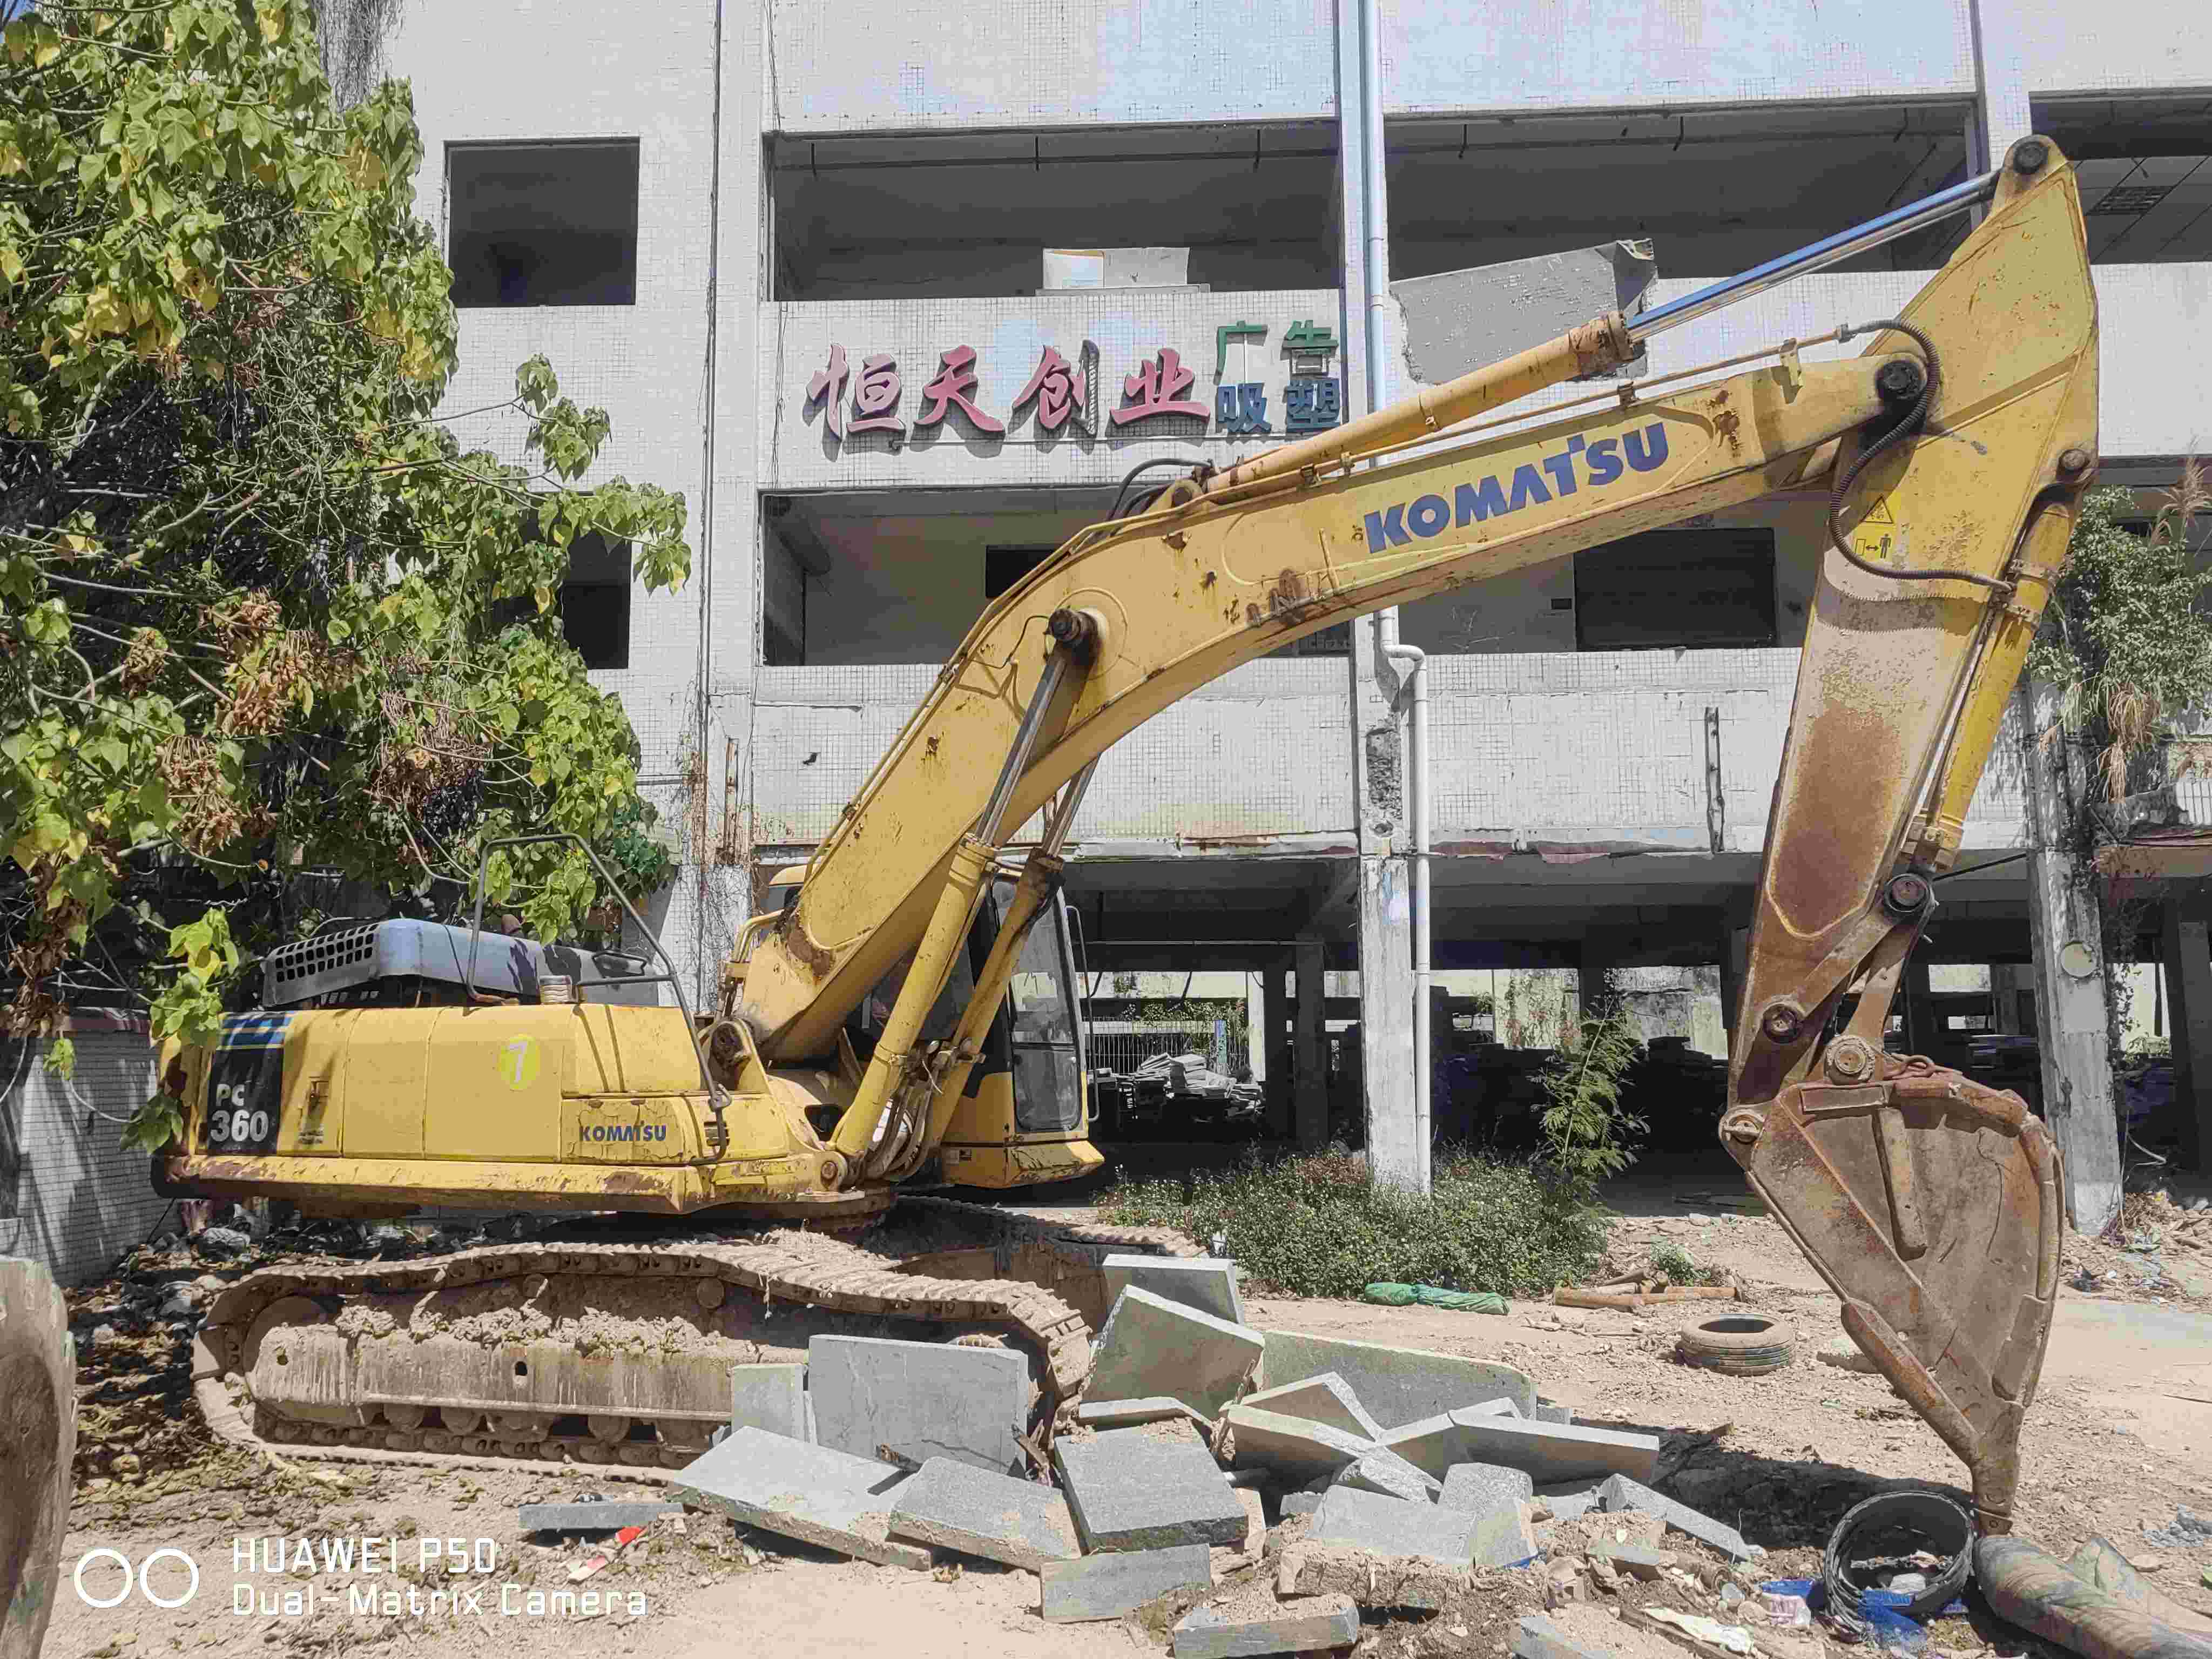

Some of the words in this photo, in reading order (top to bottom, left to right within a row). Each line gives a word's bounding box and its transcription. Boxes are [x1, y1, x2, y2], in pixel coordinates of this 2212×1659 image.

[1215, 320, 1339, 386] 广告
[806, 341, 1211, 437] 恒天创业
[1216, 379, 1340, 435] 吸塑
[1364, 422, 1669, 554] KOMATSU
[508, 1041, 527, 1083] 7
[217, 1083, 245, 1107] PC
[210, 1110, 269, 1142] 360
[578, 1121, 666, 1142] KOMATSU
